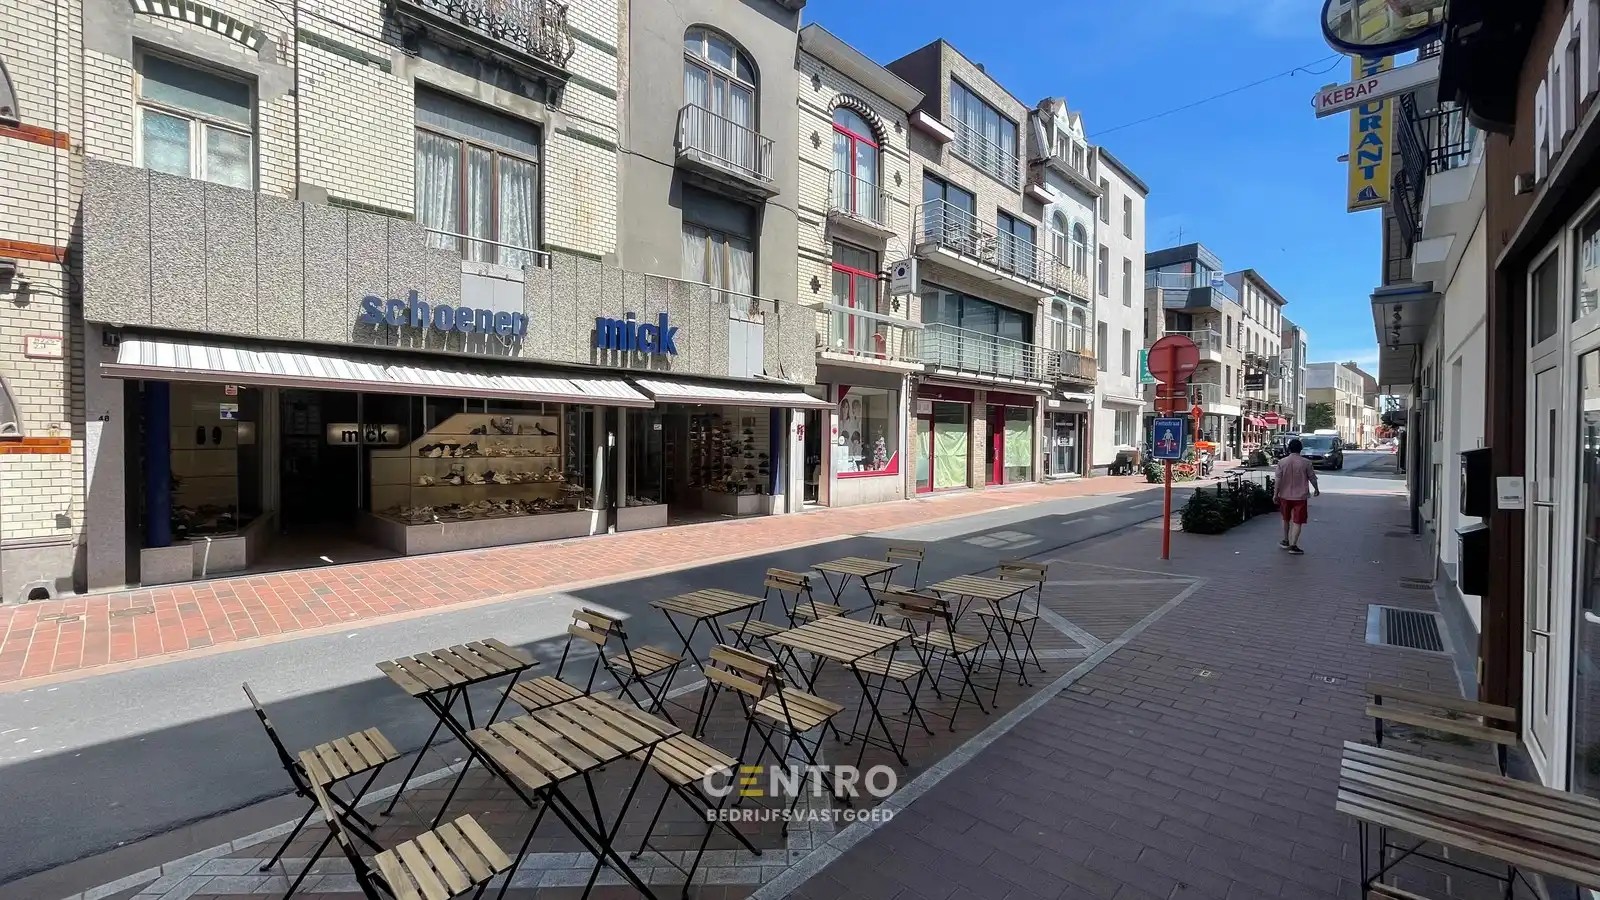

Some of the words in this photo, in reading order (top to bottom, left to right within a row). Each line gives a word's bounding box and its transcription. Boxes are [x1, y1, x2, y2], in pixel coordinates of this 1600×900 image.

[1322, 79, 1378, 107] KEBAP
[361, 289, 529, 338] schoenen
[596, 312, 678, 355] mick
